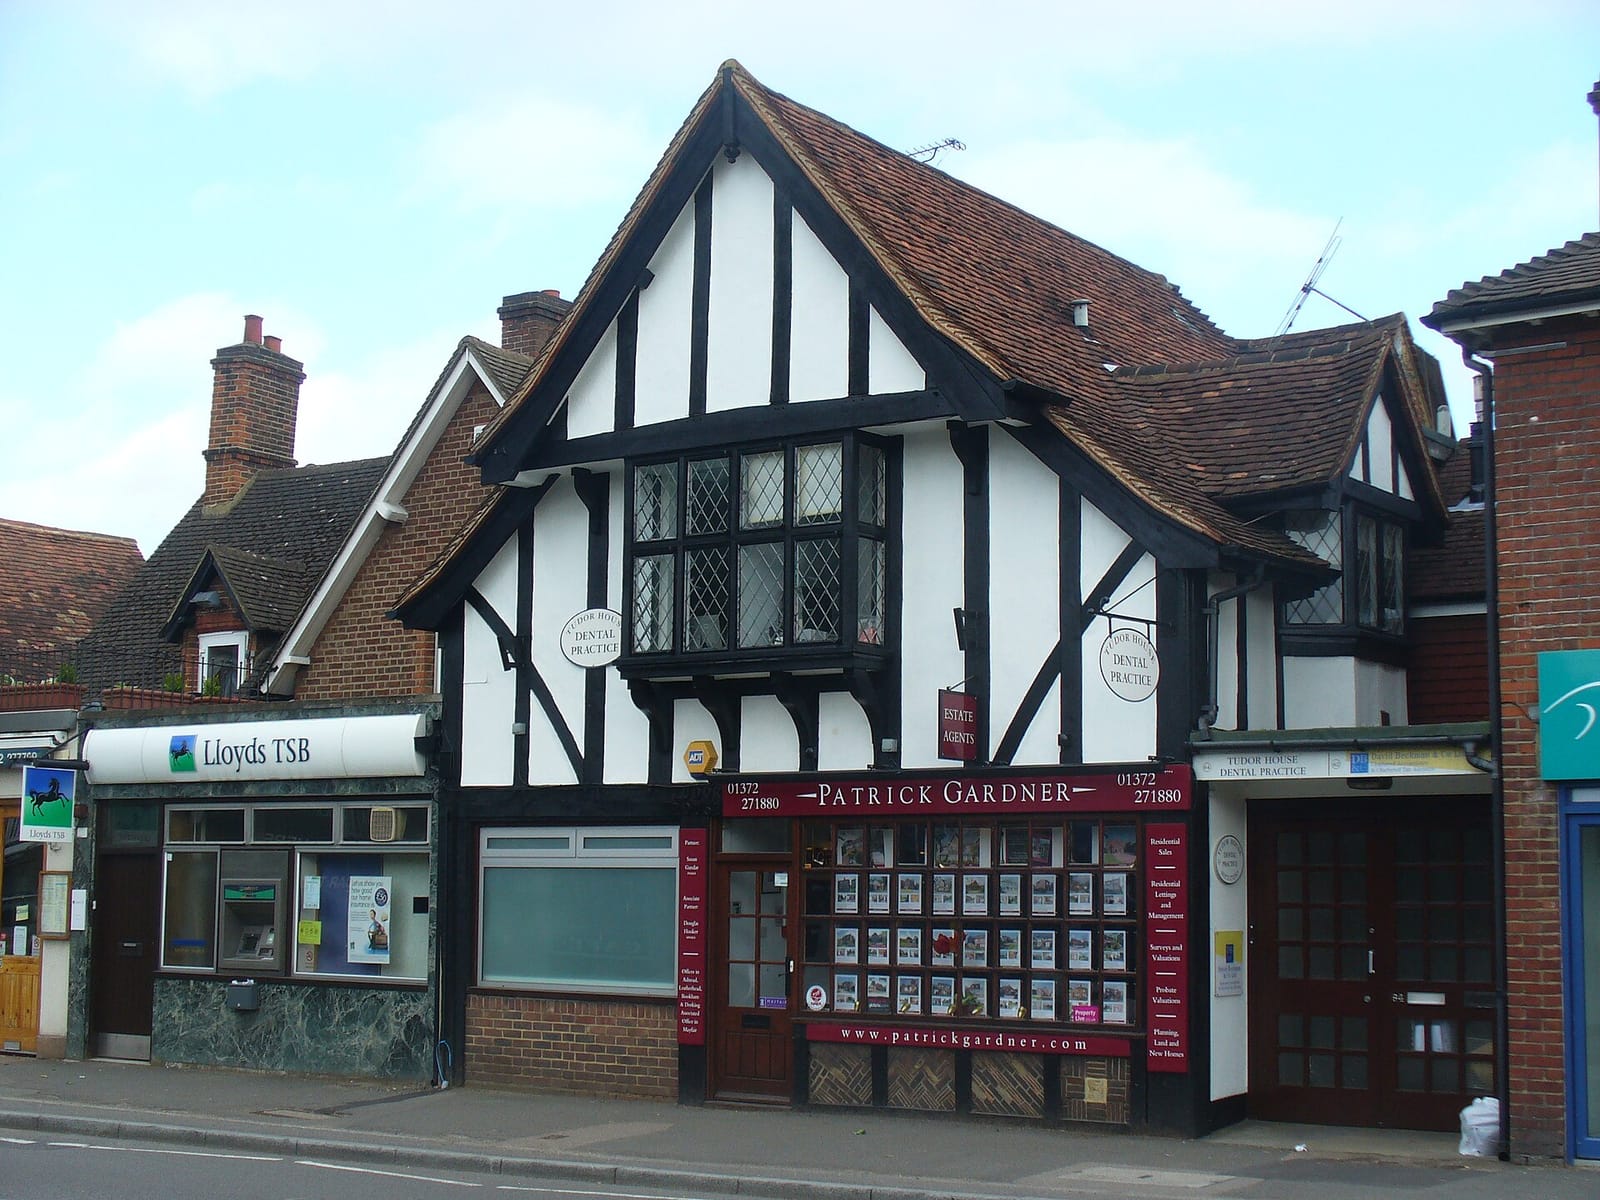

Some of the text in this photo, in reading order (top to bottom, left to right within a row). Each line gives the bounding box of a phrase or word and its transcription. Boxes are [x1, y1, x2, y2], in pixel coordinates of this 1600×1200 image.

[598, 612, 621, 627] HOUS
[575, 629, 616, 641] DENTAL
[1104, 633, 1130, 655] TUDOR
[1113, 654, 1148, 668] DENTAL
[1110, 671, 1152, 686] PRACTICE
[944, 708, 974, 722] ESTATE
[943, 730, 975, 745] AGENTS
[203, 737, 310, 772] Lloyds TSB
[688, 751, 703, 763] ADT
[1227, 755, 1298, 766] TUDOR HOUSE
[1220, 766, 1307, 777] DENTAL PRACTICE
[1117, 772, 1156, 786] 01372
[727, 782, 759, 795] 01372
[817, 780, 1070, 806] PATRICK GARDNER
[1134, 789, 1182, 803] 271880
[741, 797, 779, 810] 271880
[30, 829, 65, 840] Lloyds TSB
[1150, 838, 1181, 846] Residential
[1158, 848, 1173, 856] Sales
[1155, 891, 1177, 899] Lettings
[1148, 912, 1184, 920] Management
[1149, 943, 1171, 952] Surveys
[1152, 954, 1181, 962] Valuations
[1155, 986, 1177, 994] Probate
[1152, 996, 1181, 1004] Valuations
[841, 1027, 1088, 1050] www.patrickgardner.com
[1154, 1039, 1168, 1047] Land
[1164, 1050, 1185, 1058] Homes
